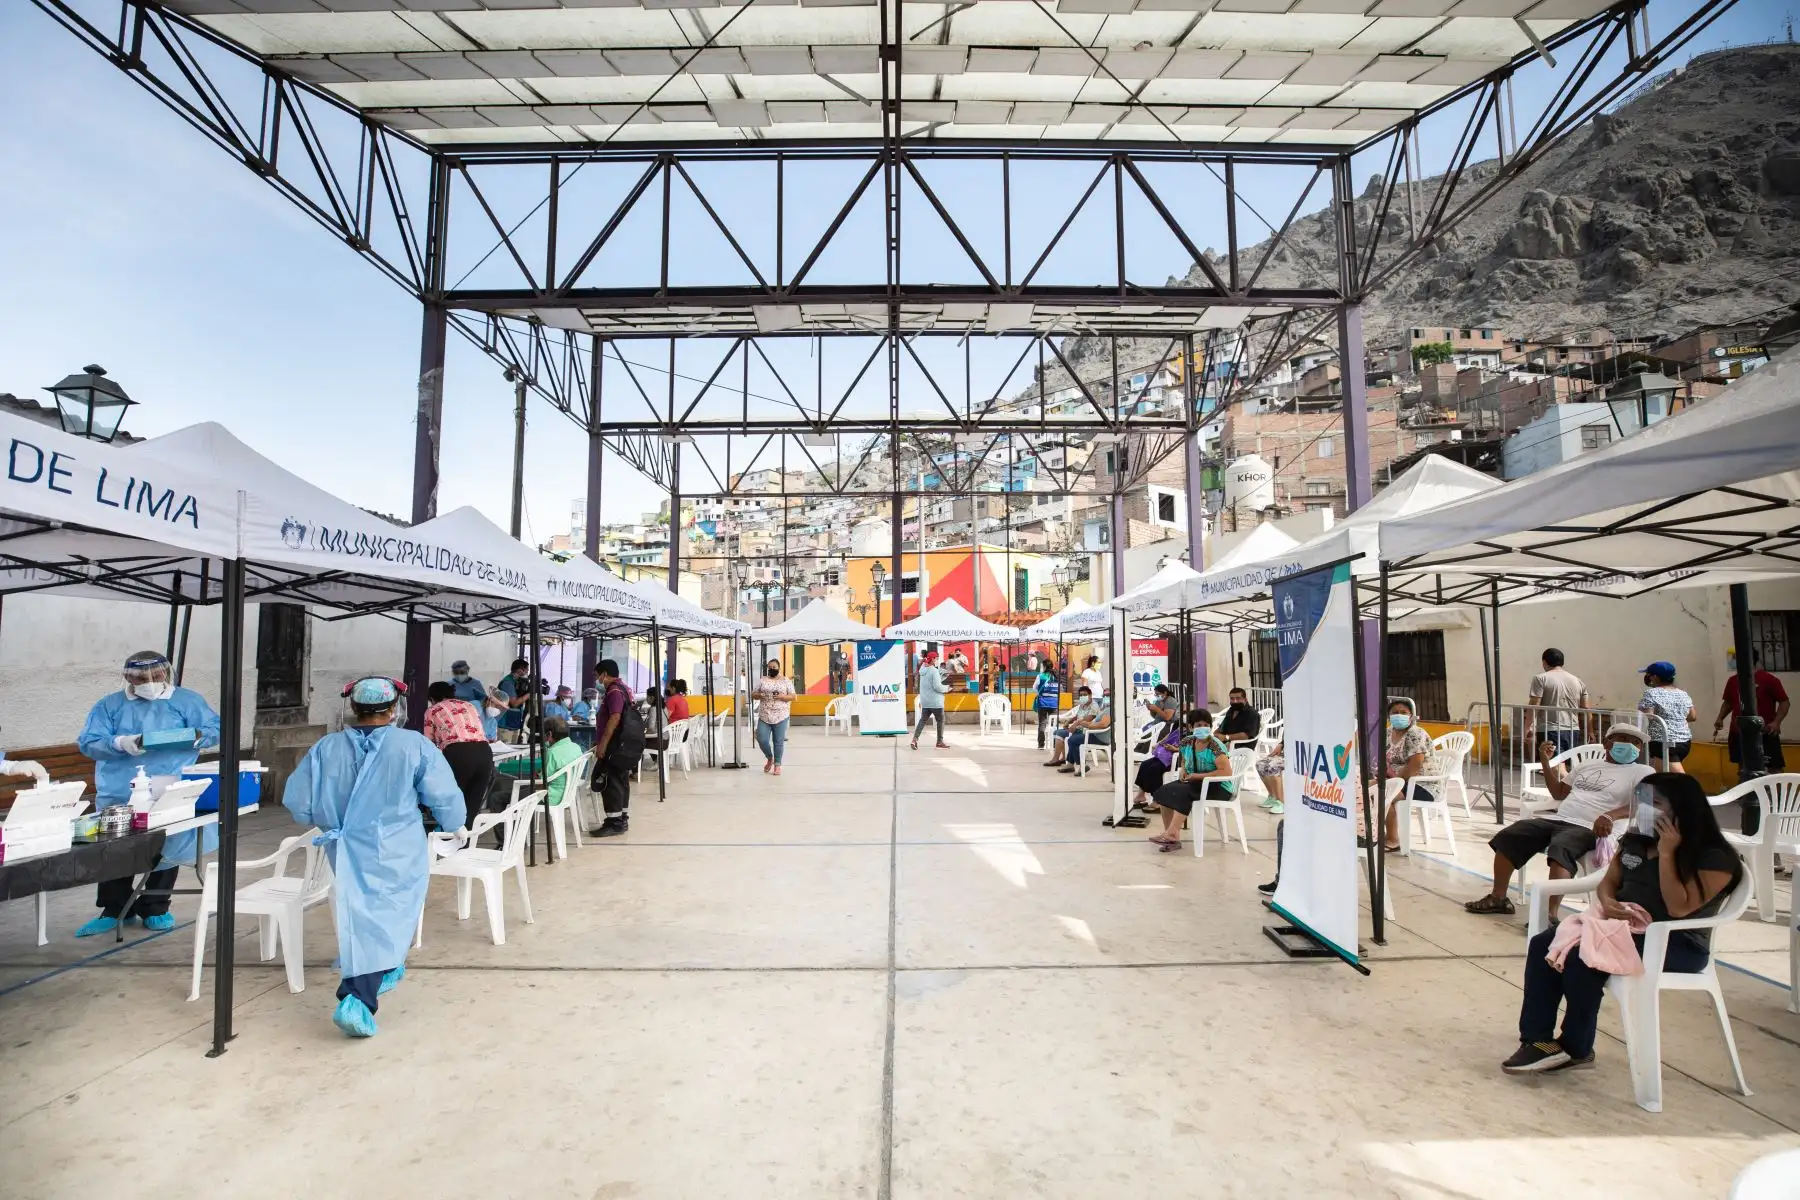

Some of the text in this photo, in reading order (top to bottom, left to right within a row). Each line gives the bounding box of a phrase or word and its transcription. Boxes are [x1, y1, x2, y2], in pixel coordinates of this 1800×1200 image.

[8, 438, 199, 529] DE LIMA
[1237, 473, 1266, 482] KHOR
[320, 526, 529, 592] MUNICIPALIDAD DE LIMA
[562, 580, 627, 606] MUNICIPALIDAD
[1210, 571, 1262, 594] MUNICIPALIDAD
[906, 629, 972, 638] MUNICIPALIDAD
[1278, 630, 1304, 646] LIMA
[863, 684, 891, 695] LIMA
[1293, 740, 1333, 784] IMA
[1310, 776, 1345, 805] cuida
